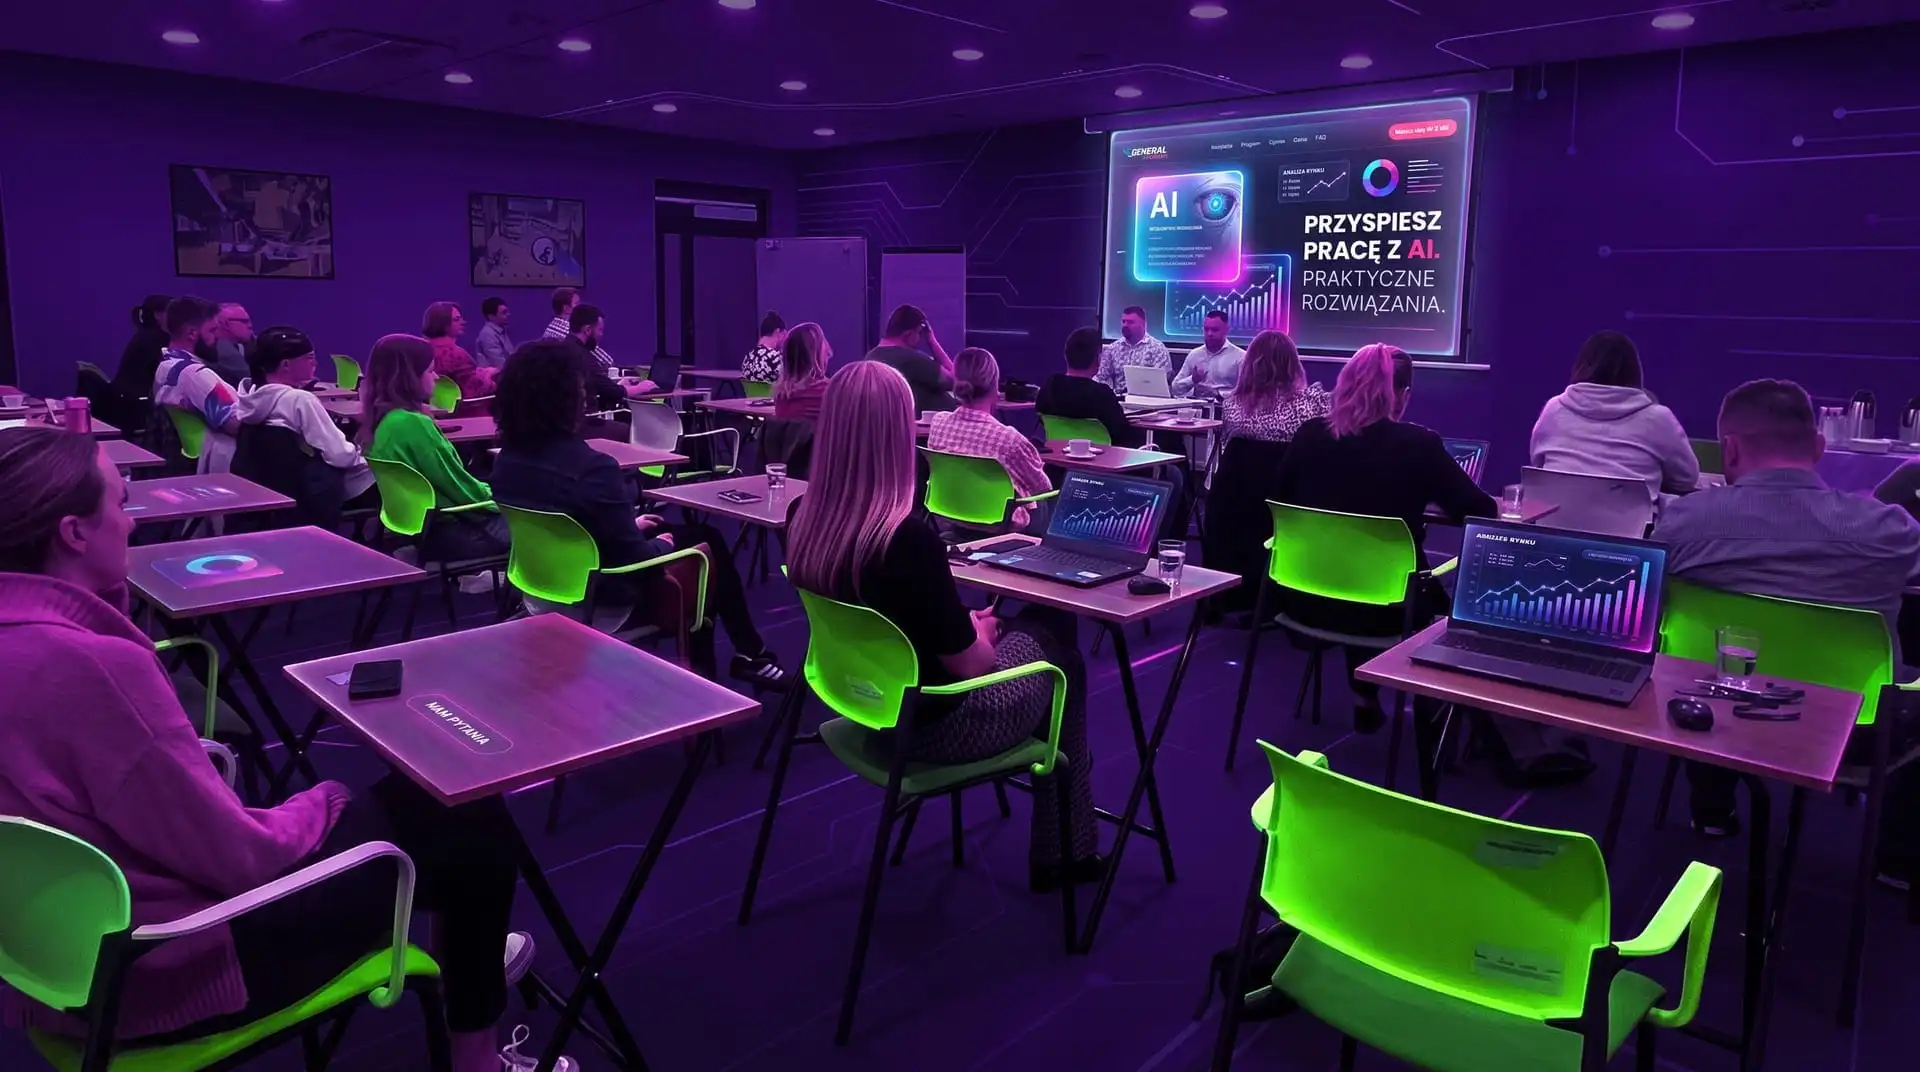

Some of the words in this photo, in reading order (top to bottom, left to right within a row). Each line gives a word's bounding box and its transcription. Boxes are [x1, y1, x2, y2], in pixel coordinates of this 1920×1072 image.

[1131, 146, 1167, 156] GENERAL
[1150, 191, 1178, 219] AI
[1304, 210, 1442, 234] PRZYSPIESZ
[1304, 240, 1381, 264] PRACĘ
[1387, 240, 1401, 260] Z
[1408, 239, 1440, 259] AI.
[1303, 270, 1435, 287] PRAKTYCZNE
[1302, 294, 1446, 316] ROZWIĄZANIA.
[1509, 537, 1536, 546] RYNKU
[424, 701, 453, 718] MAM
[446, 716, 490, 745] PYTANIA
